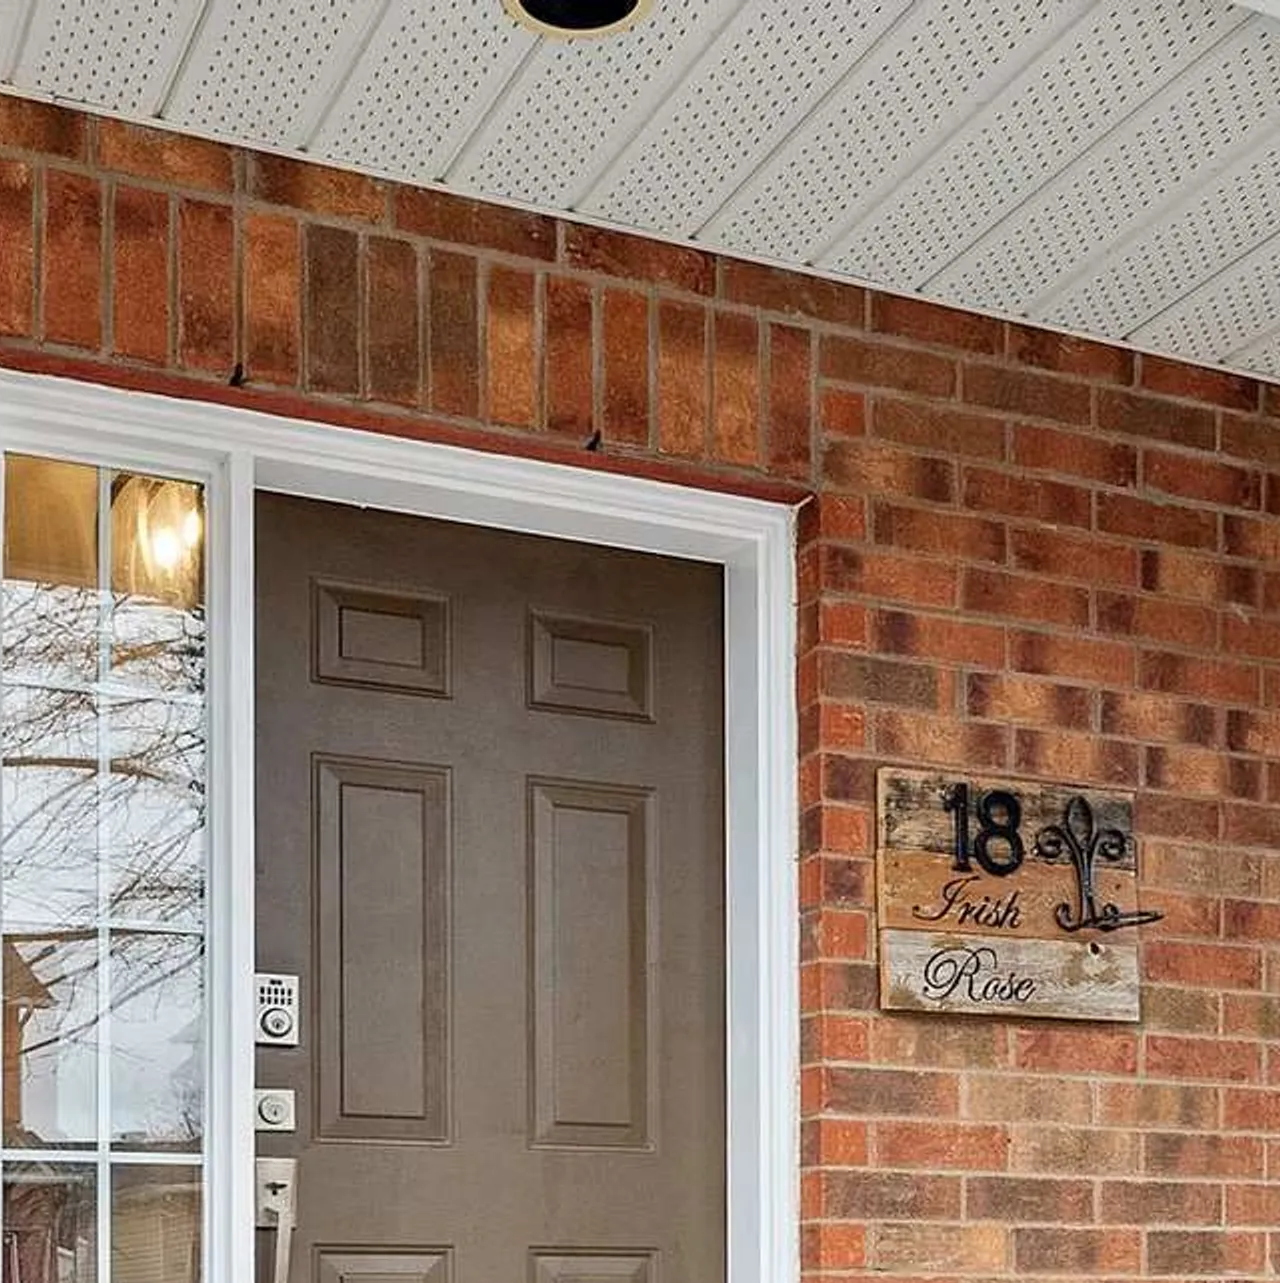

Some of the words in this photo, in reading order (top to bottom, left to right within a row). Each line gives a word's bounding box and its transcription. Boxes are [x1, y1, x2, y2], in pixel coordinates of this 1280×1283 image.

[942, 782, 1025, 878] 18
[912, 875, 1020, 929] Irish
[922, 947, 1036, 1001] Rose
